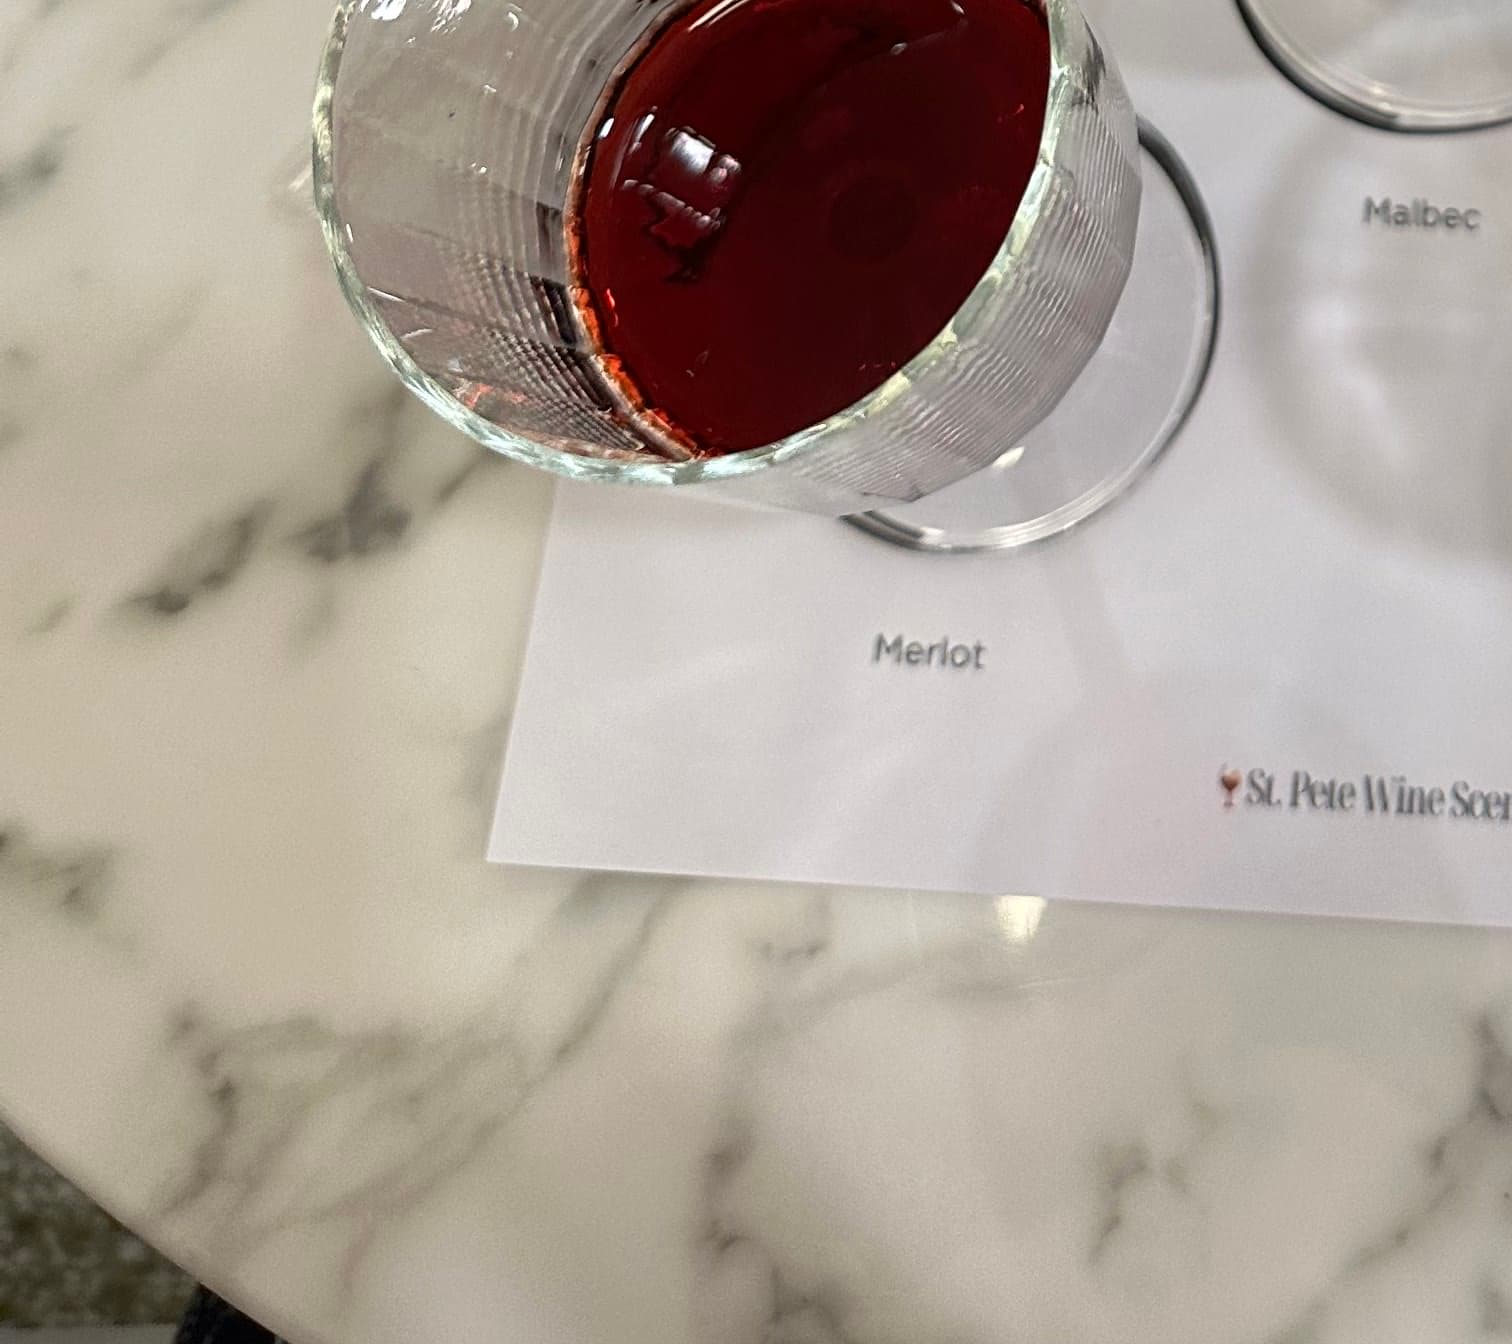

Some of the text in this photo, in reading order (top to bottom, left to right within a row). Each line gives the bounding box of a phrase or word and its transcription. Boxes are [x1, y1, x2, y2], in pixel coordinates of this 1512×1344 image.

[1362, 195, 1481, 231] Malbec
[872, 631, 985, 670] Merlot
[1245, 768, 1281, 806] St.
[1290, 769, 1356, 812] Pete
[1363, 773, 1446, 818] Wine
